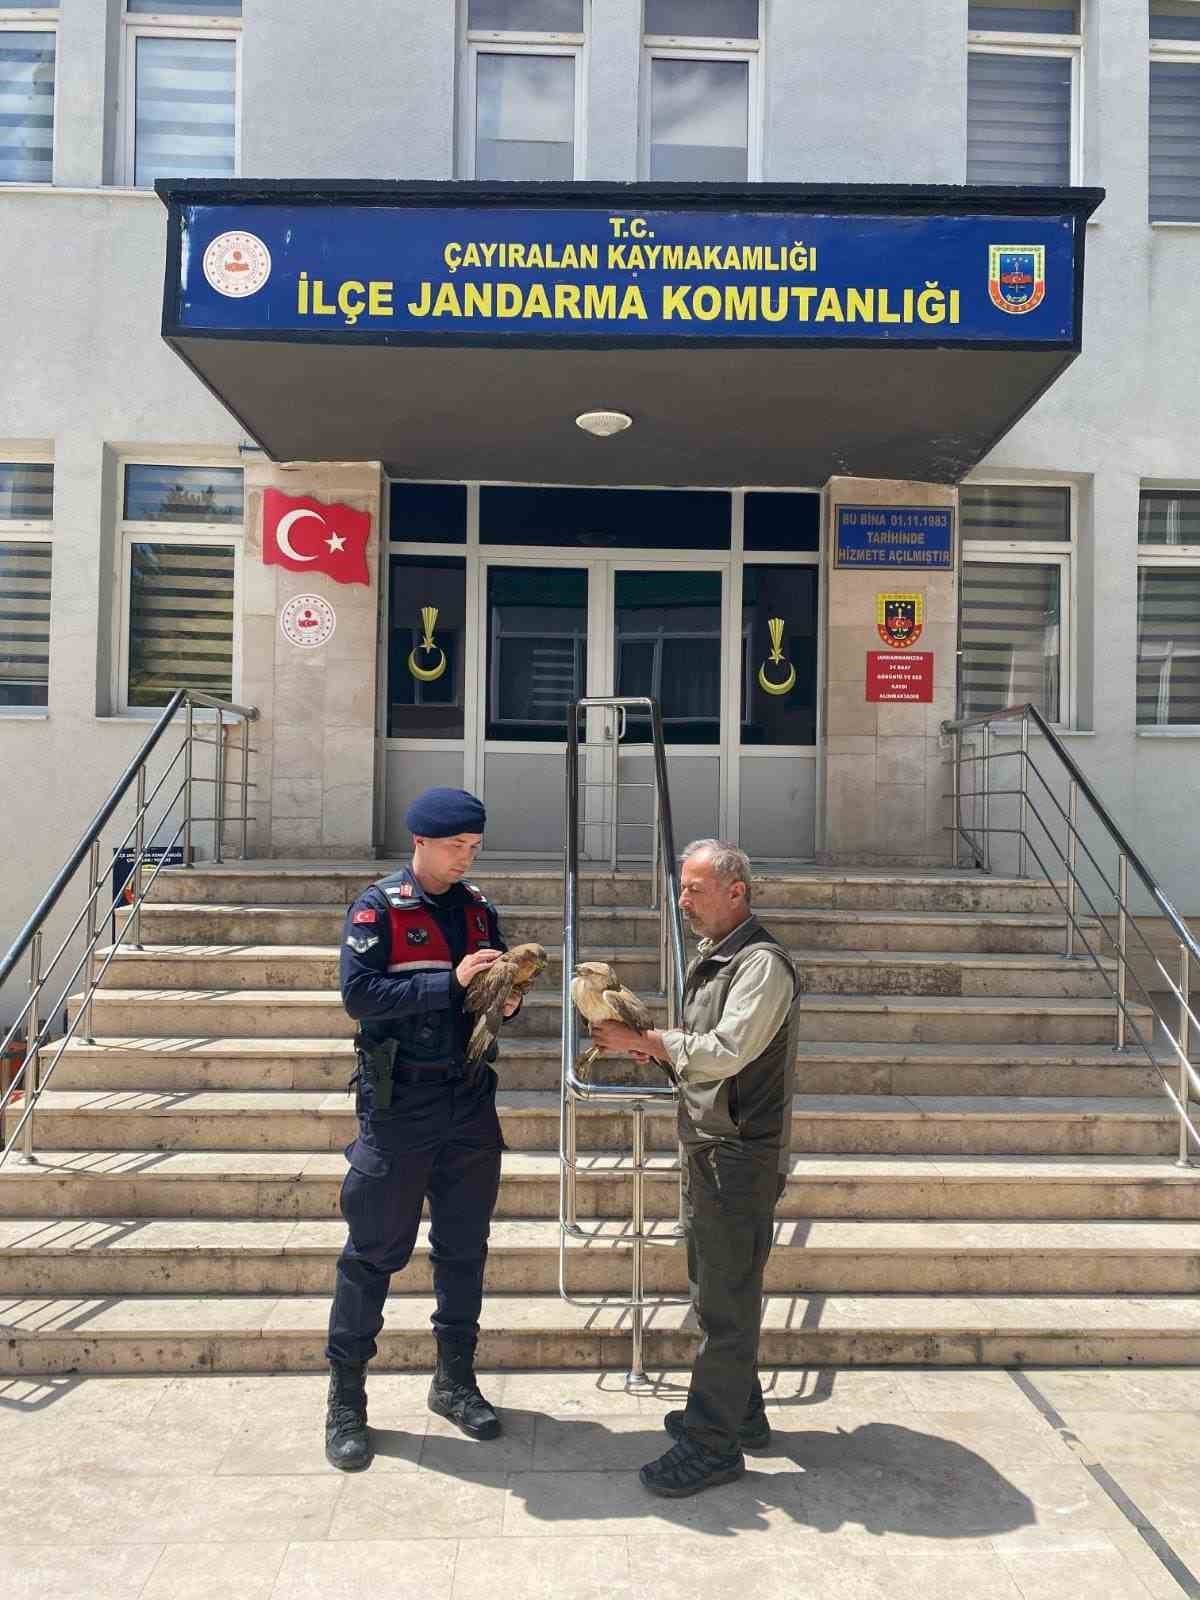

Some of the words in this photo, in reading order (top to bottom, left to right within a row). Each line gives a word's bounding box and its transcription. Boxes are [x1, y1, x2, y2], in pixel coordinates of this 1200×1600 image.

[609, 217, 655, 239] T.C.
[443, 242, 598, 273] ÇAYIRALAN
[607, 241, 817, 273] KAYMAKAMLIĞI
[297, 271, 394, 325] İLÇE
[407, 281, 648, 321] JANDARMA
[662, 280, 961, 325] KOMUTANLIĞI
[842, 512, 857, 526] BU
[860, 512, 886, 526] BİNA
[890, 514, 948, 528] 01.11.1983
[866, 530, 926, 545] TARİHİNDE
[839, 545, 886, 561] HİZMETE
